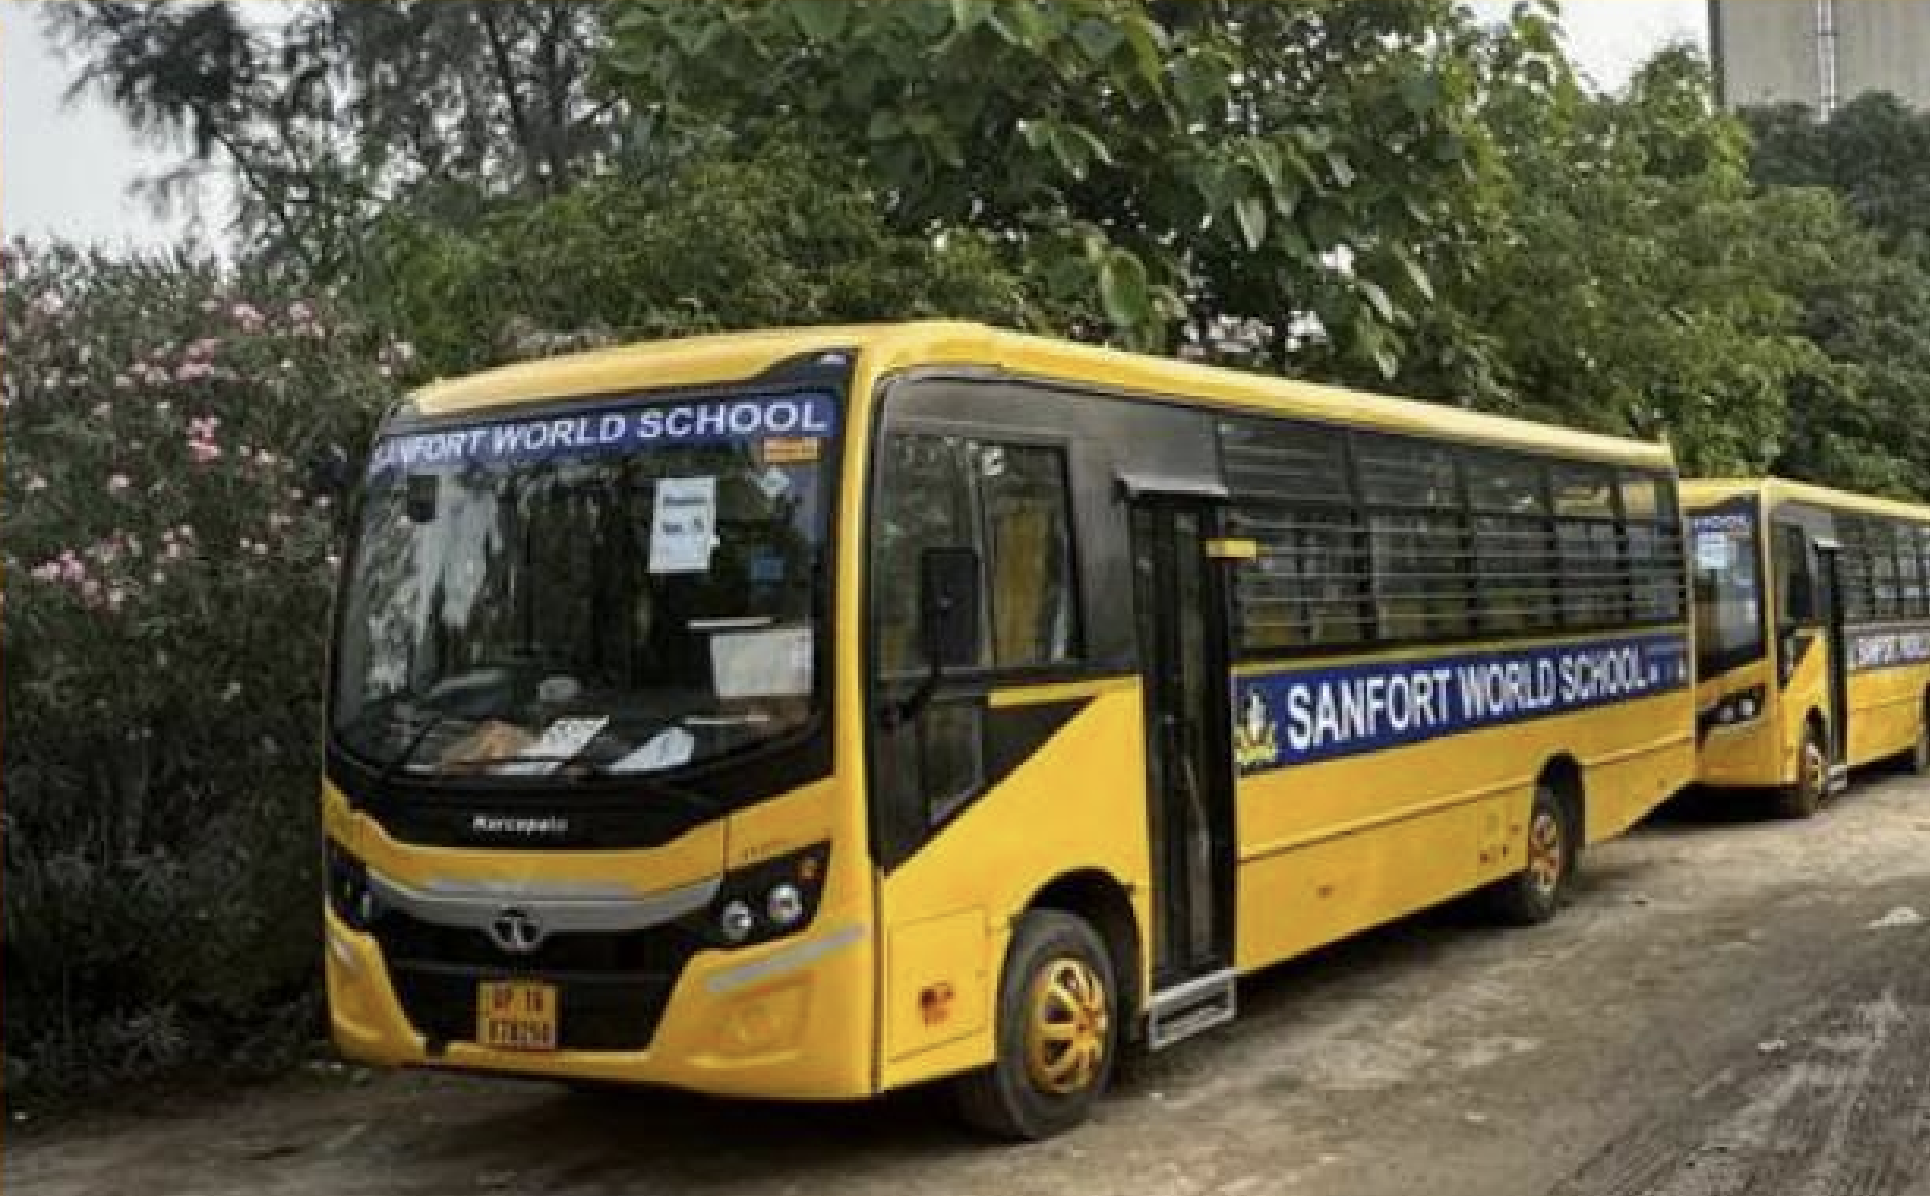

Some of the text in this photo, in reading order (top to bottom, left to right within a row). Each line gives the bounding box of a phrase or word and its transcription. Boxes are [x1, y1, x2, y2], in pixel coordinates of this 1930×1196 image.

[493, 416, 626, 454] WORLD
[636, 398, 828, 438] SCHOOL
[1286, 668, 1450, 750] SANFORT
[1456, 656, 1551, 720] WORLD
[1559, 645, 1648, 703] SCHOOL
